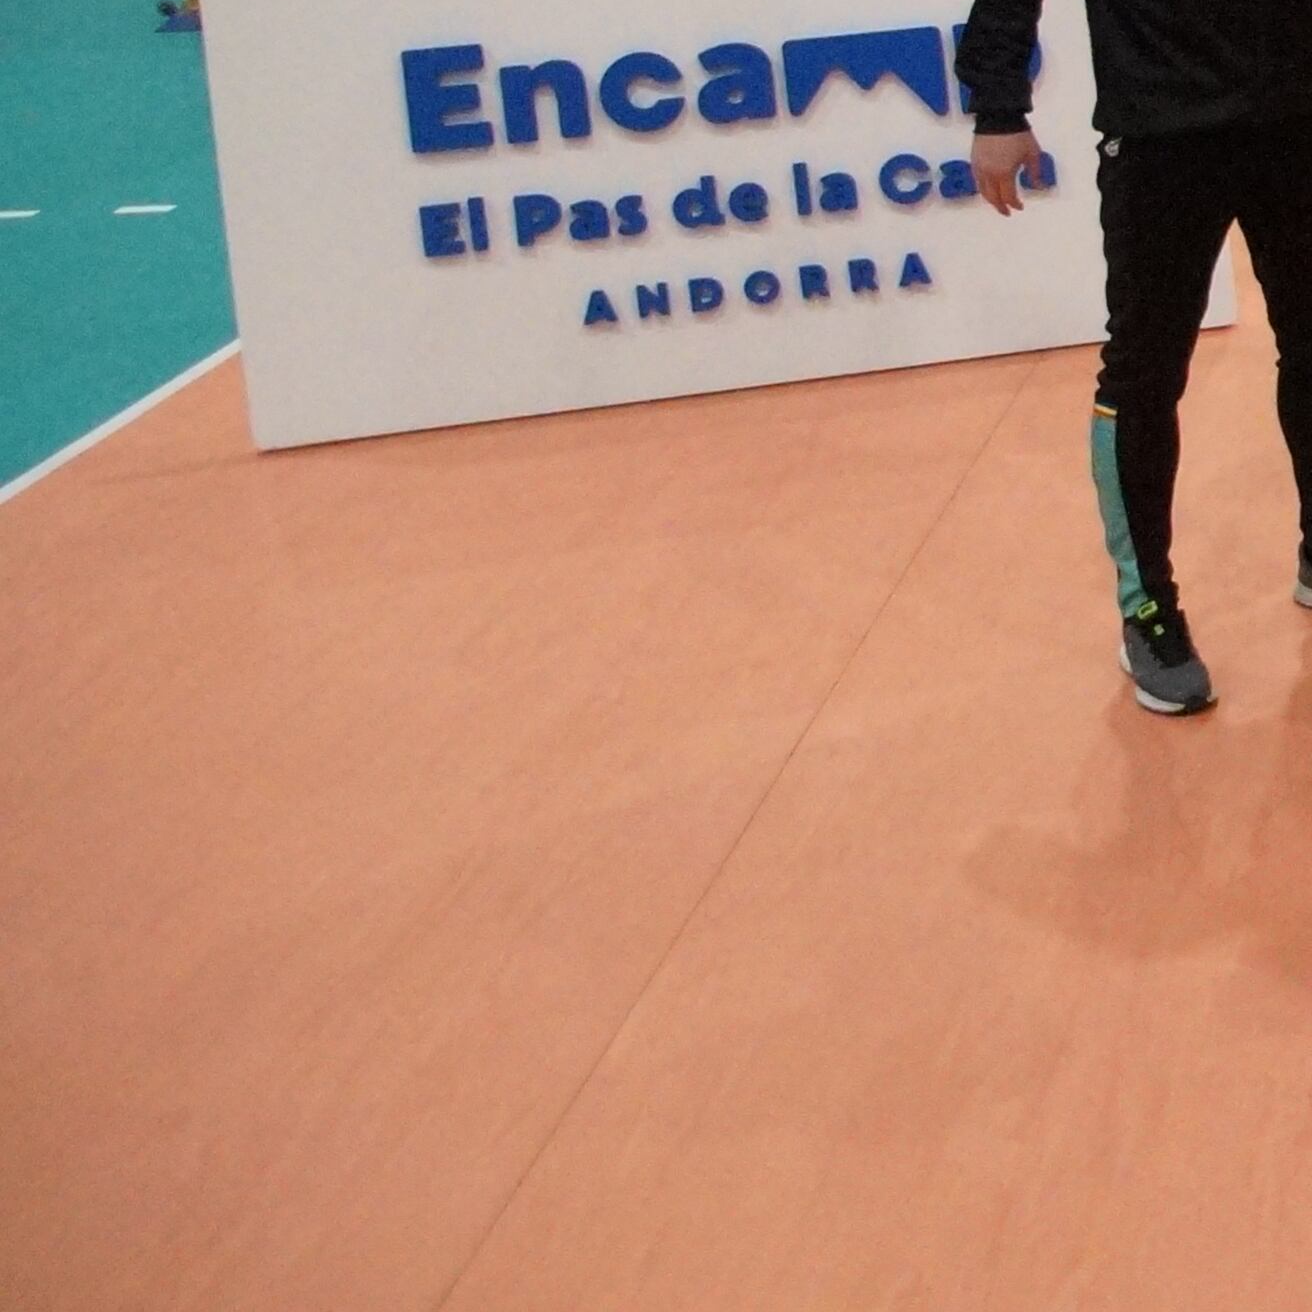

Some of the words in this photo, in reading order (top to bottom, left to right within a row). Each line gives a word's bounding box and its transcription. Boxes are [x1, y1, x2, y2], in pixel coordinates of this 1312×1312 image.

[400, 22, 1042, 155] Encam
[418, 196, 490, 258] El
[512, 192, 649, 248] Pas
[671, 174, 771, 229] de
[792, 162, 859, 217] la
[878, 152, 1057, 206] Caa
[582, 252, 933, 327] ANDORRA
